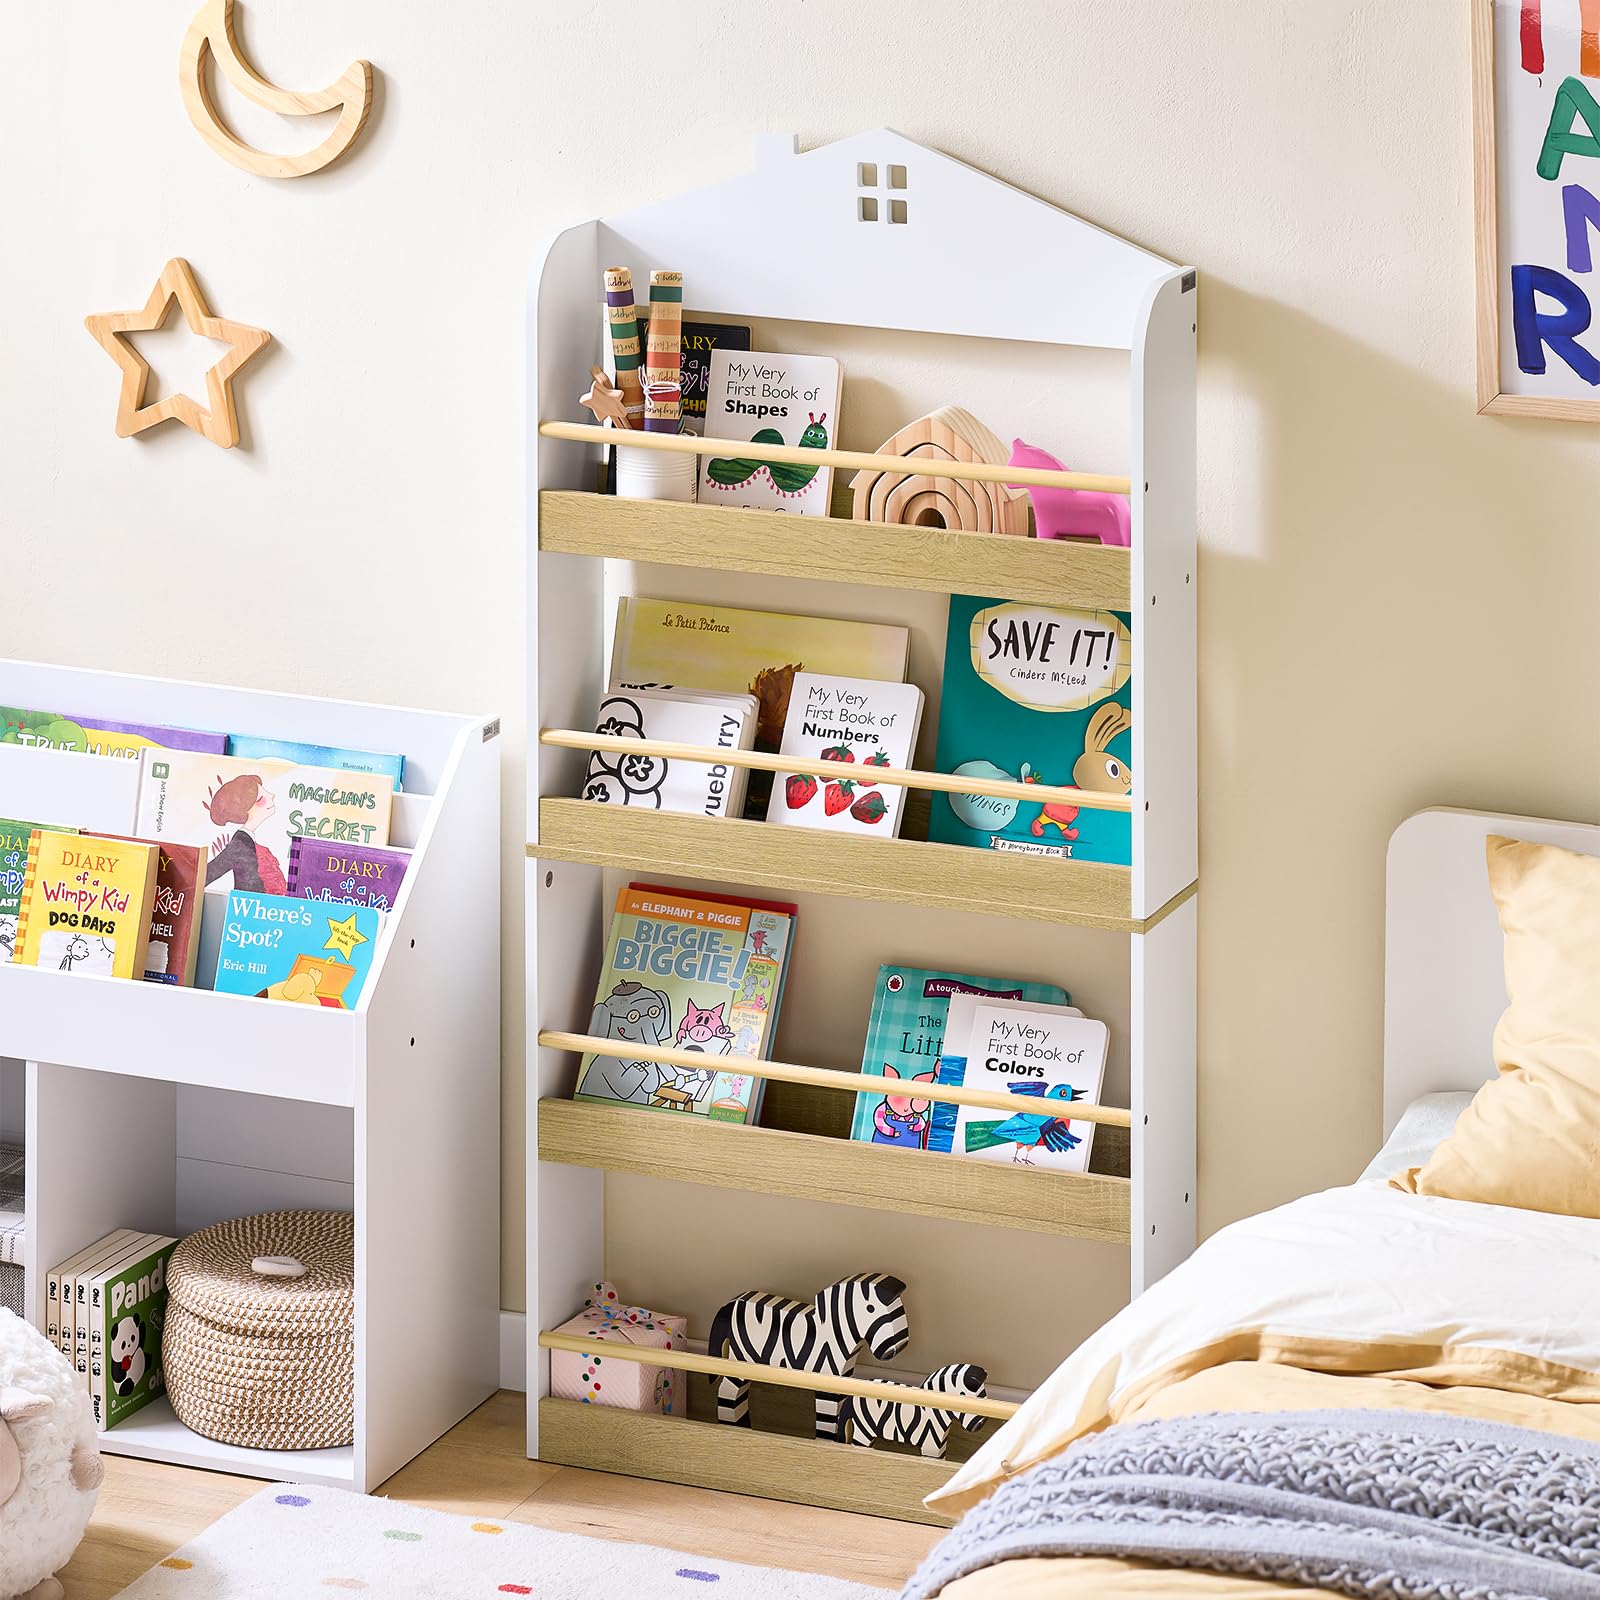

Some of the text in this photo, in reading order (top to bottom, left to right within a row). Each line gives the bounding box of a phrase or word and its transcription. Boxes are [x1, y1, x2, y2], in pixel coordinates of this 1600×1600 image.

[1511, 264, 1600, 387] R
[728, 362, 786, 384] My Very
[726, 381, 821, 401] First Book of
[724, 399, 789, 419] Shapes
[662, 613, 731, 633] Le Petit Prince
[988, 618, 1115, 671] SAVE IT!
[1010, 667, 1047, 681] Cinders
[808, 685, 869, 710] My Very
[805, 704, 899, 728] First Book of
[801, 721, 881, 744] Numbers
[289, 782, 376, 810] MAGICIAN'S
[286, 810, 377, 844] SECRET
[62, 850, 119, 873] DIARY
[326, 856, 388, 880] DIARY
[76, 871, 100, 887] of a
[339, 877, 367, 896] of a
[42, 880, 130, 913] Wimpy Kid
[153, 885, 185, 915] Kid
[49, 911, 116, 934] DOG DAYS
[231, 896, 312, 926] Where's
[641, 902, 696, 919] ELEPHANT
[696, 912, 705, 920] &
[707, 911, 743, 926] PIGGIE
[151, 922, 174, 937] HEEL
[226, 922, 284, 949] Spot?
[633, 919, 733, 954] BIGGIE-
[222, 958, 268, 975] Eric Hill
[612, 937, 752, 990] BIGGIE!
[928, 983, 936, 992] A
[918, 1015, 942, 1028] The
[991, 1020, 1052, 1045] My Very
[987, 1038, 1085, 1064] First Book of
[984, 1057, 1045, 1078] Colors
[92, 1288, 101, 1308] Oho!
